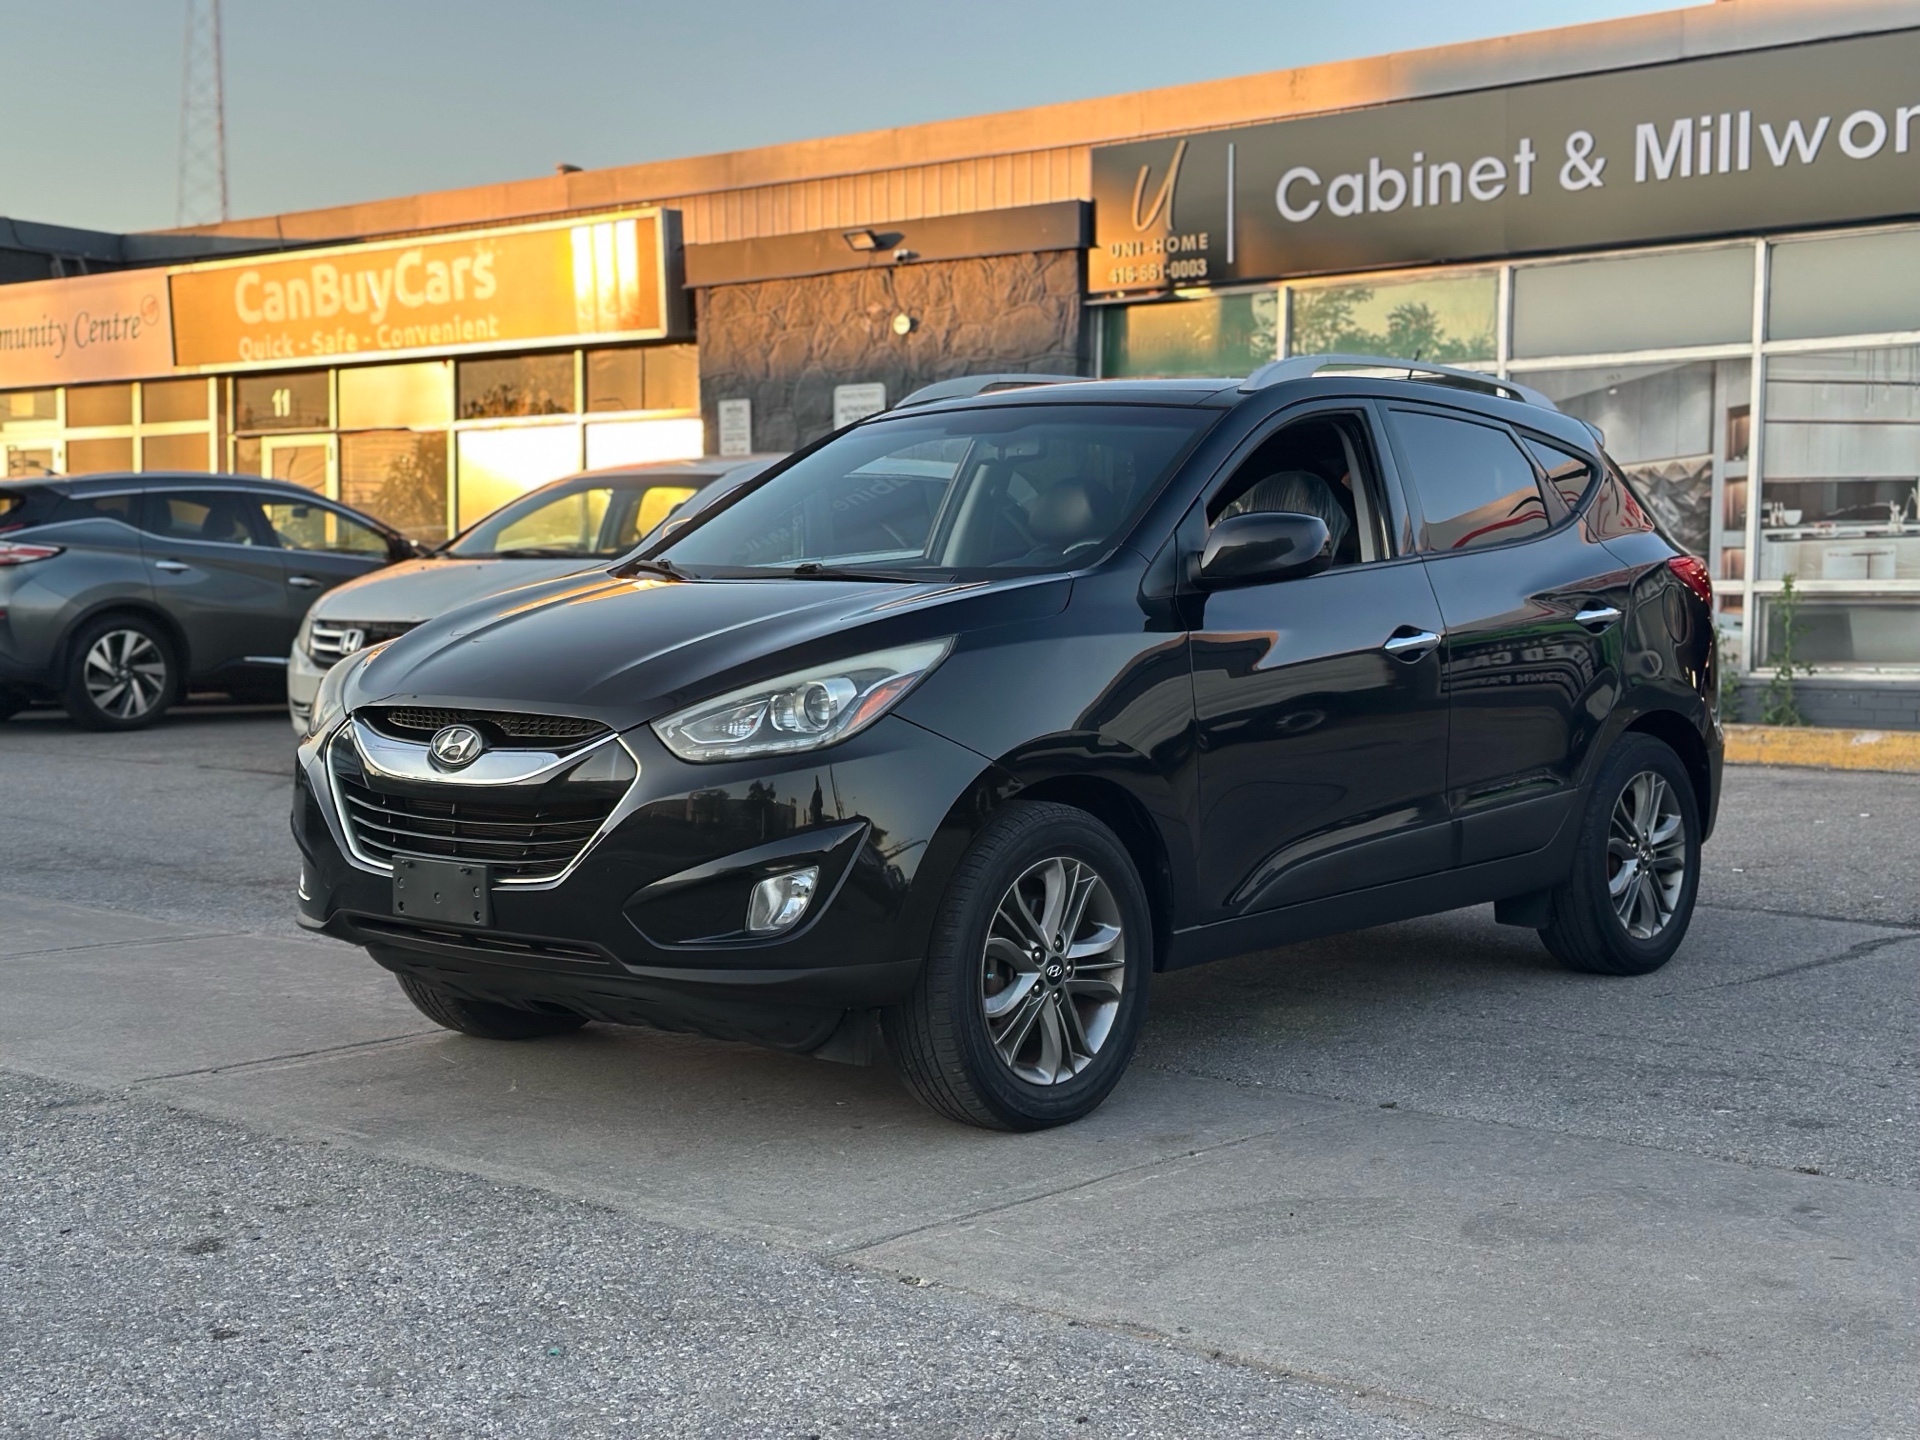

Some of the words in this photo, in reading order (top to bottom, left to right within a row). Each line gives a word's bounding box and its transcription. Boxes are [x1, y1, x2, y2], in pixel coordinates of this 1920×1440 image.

[1276, 138, 1536, 222] Cabinet
[1559, 130, 1606, 191] &
[1111, 232, 1209, 259] UNI-HOME
[234, 248, 498, 325] CanBuyCars
[74, 311, 141, 349] Centre
[238, 332, 294, 362] Quick
[311, 327, 358, 355] Safe
[376, 313, 500, 349] Convenient
[271, 388, 291, 418] 11
